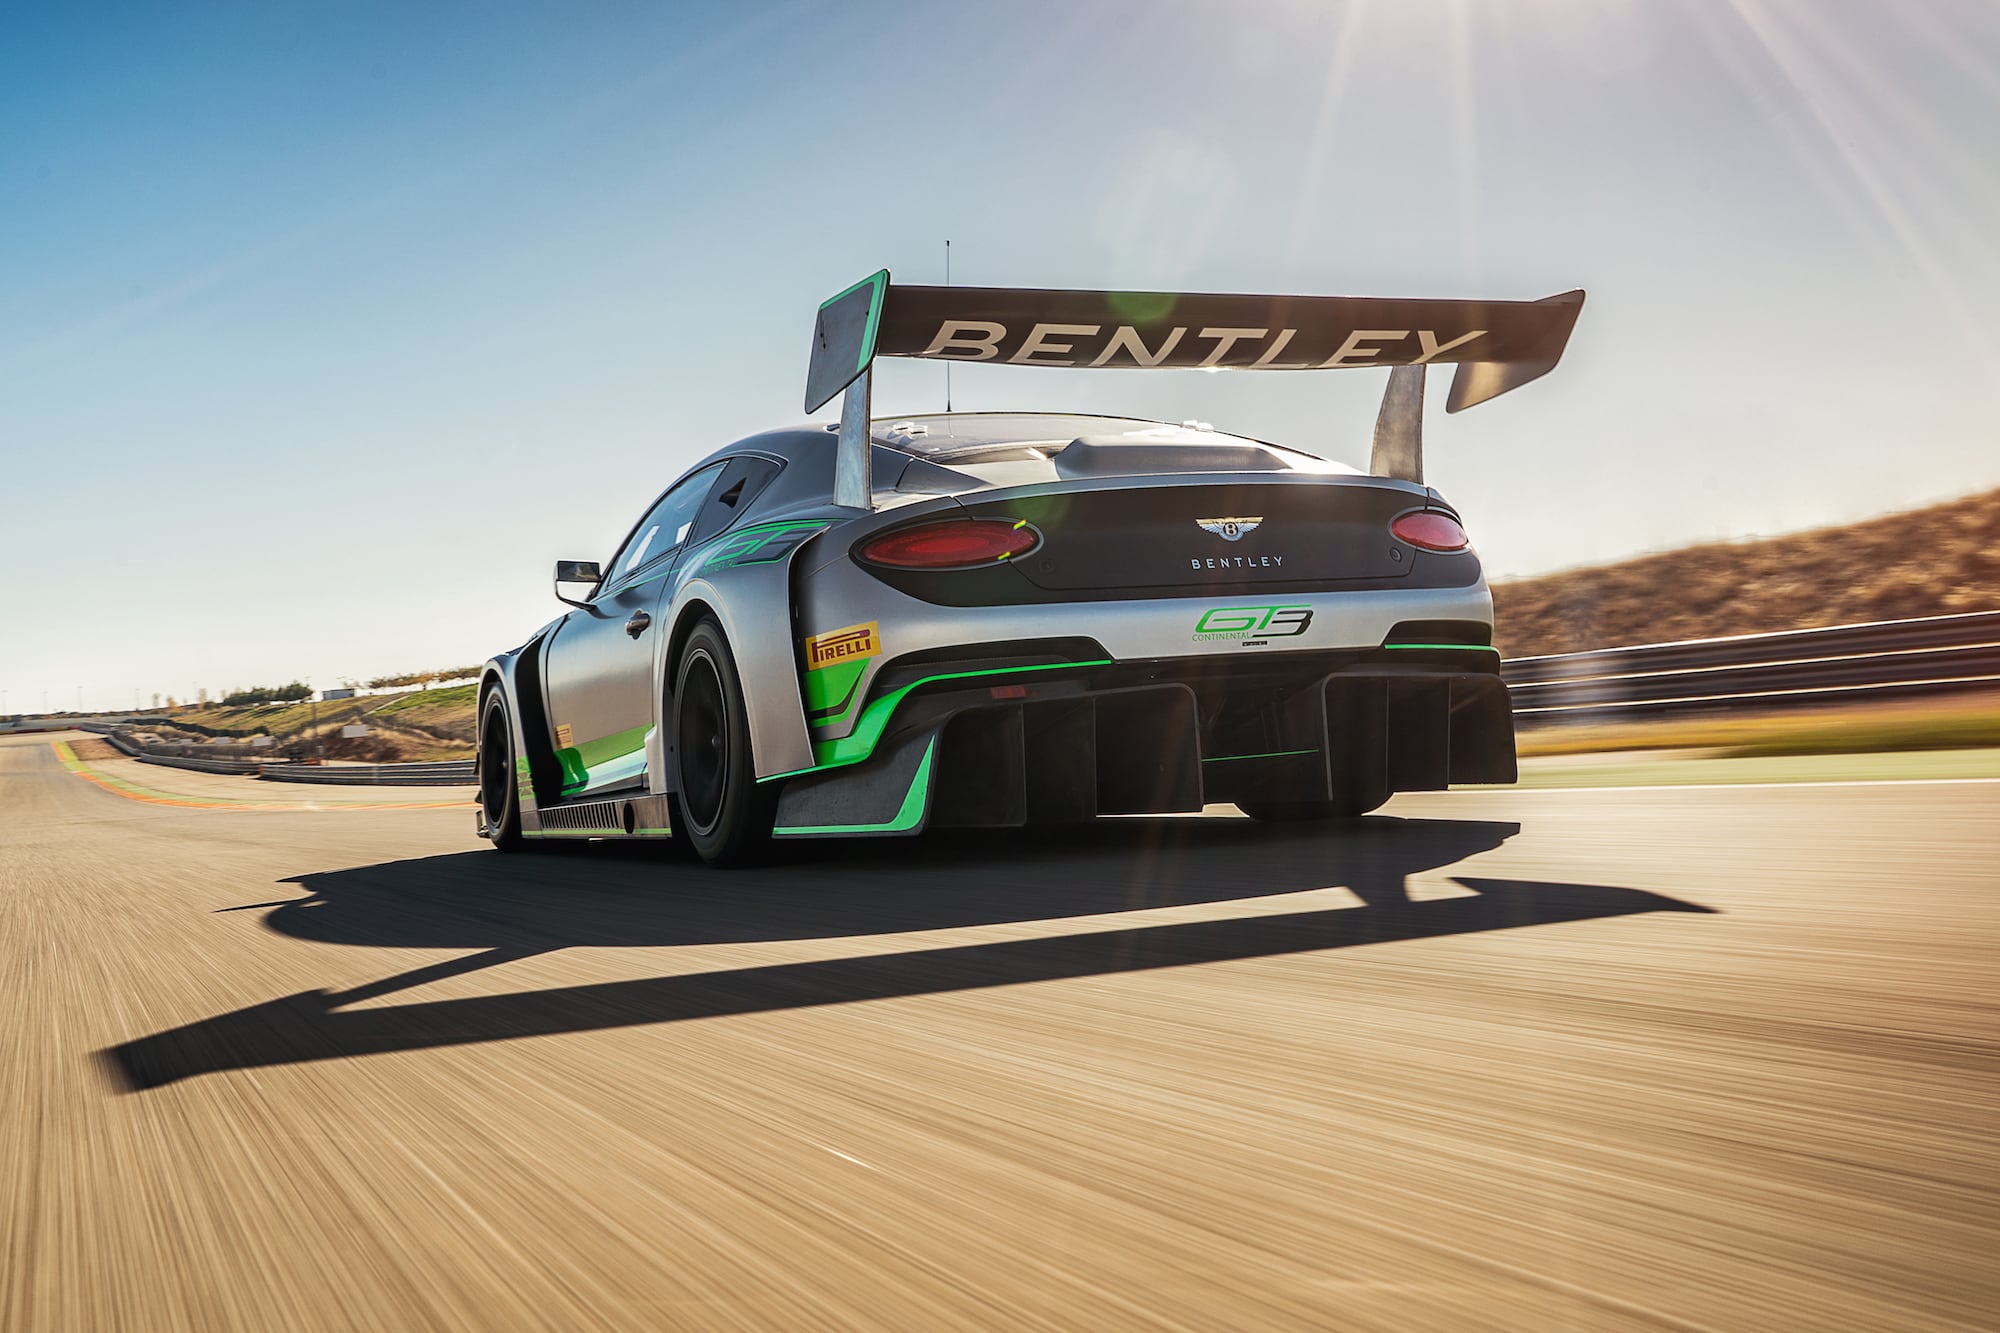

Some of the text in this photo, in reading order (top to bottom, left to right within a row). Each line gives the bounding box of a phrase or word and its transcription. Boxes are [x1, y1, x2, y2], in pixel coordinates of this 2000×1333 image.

[925, 320, 1488, 368] BENTLEY
[1191, 556, 1283, 570] BENTLEY
[1192, 632, 1250, 641] CONTINENTAL
[1195, 604, 1314, 638] GT3
[811, 629, 872, 663] PIRELLI
